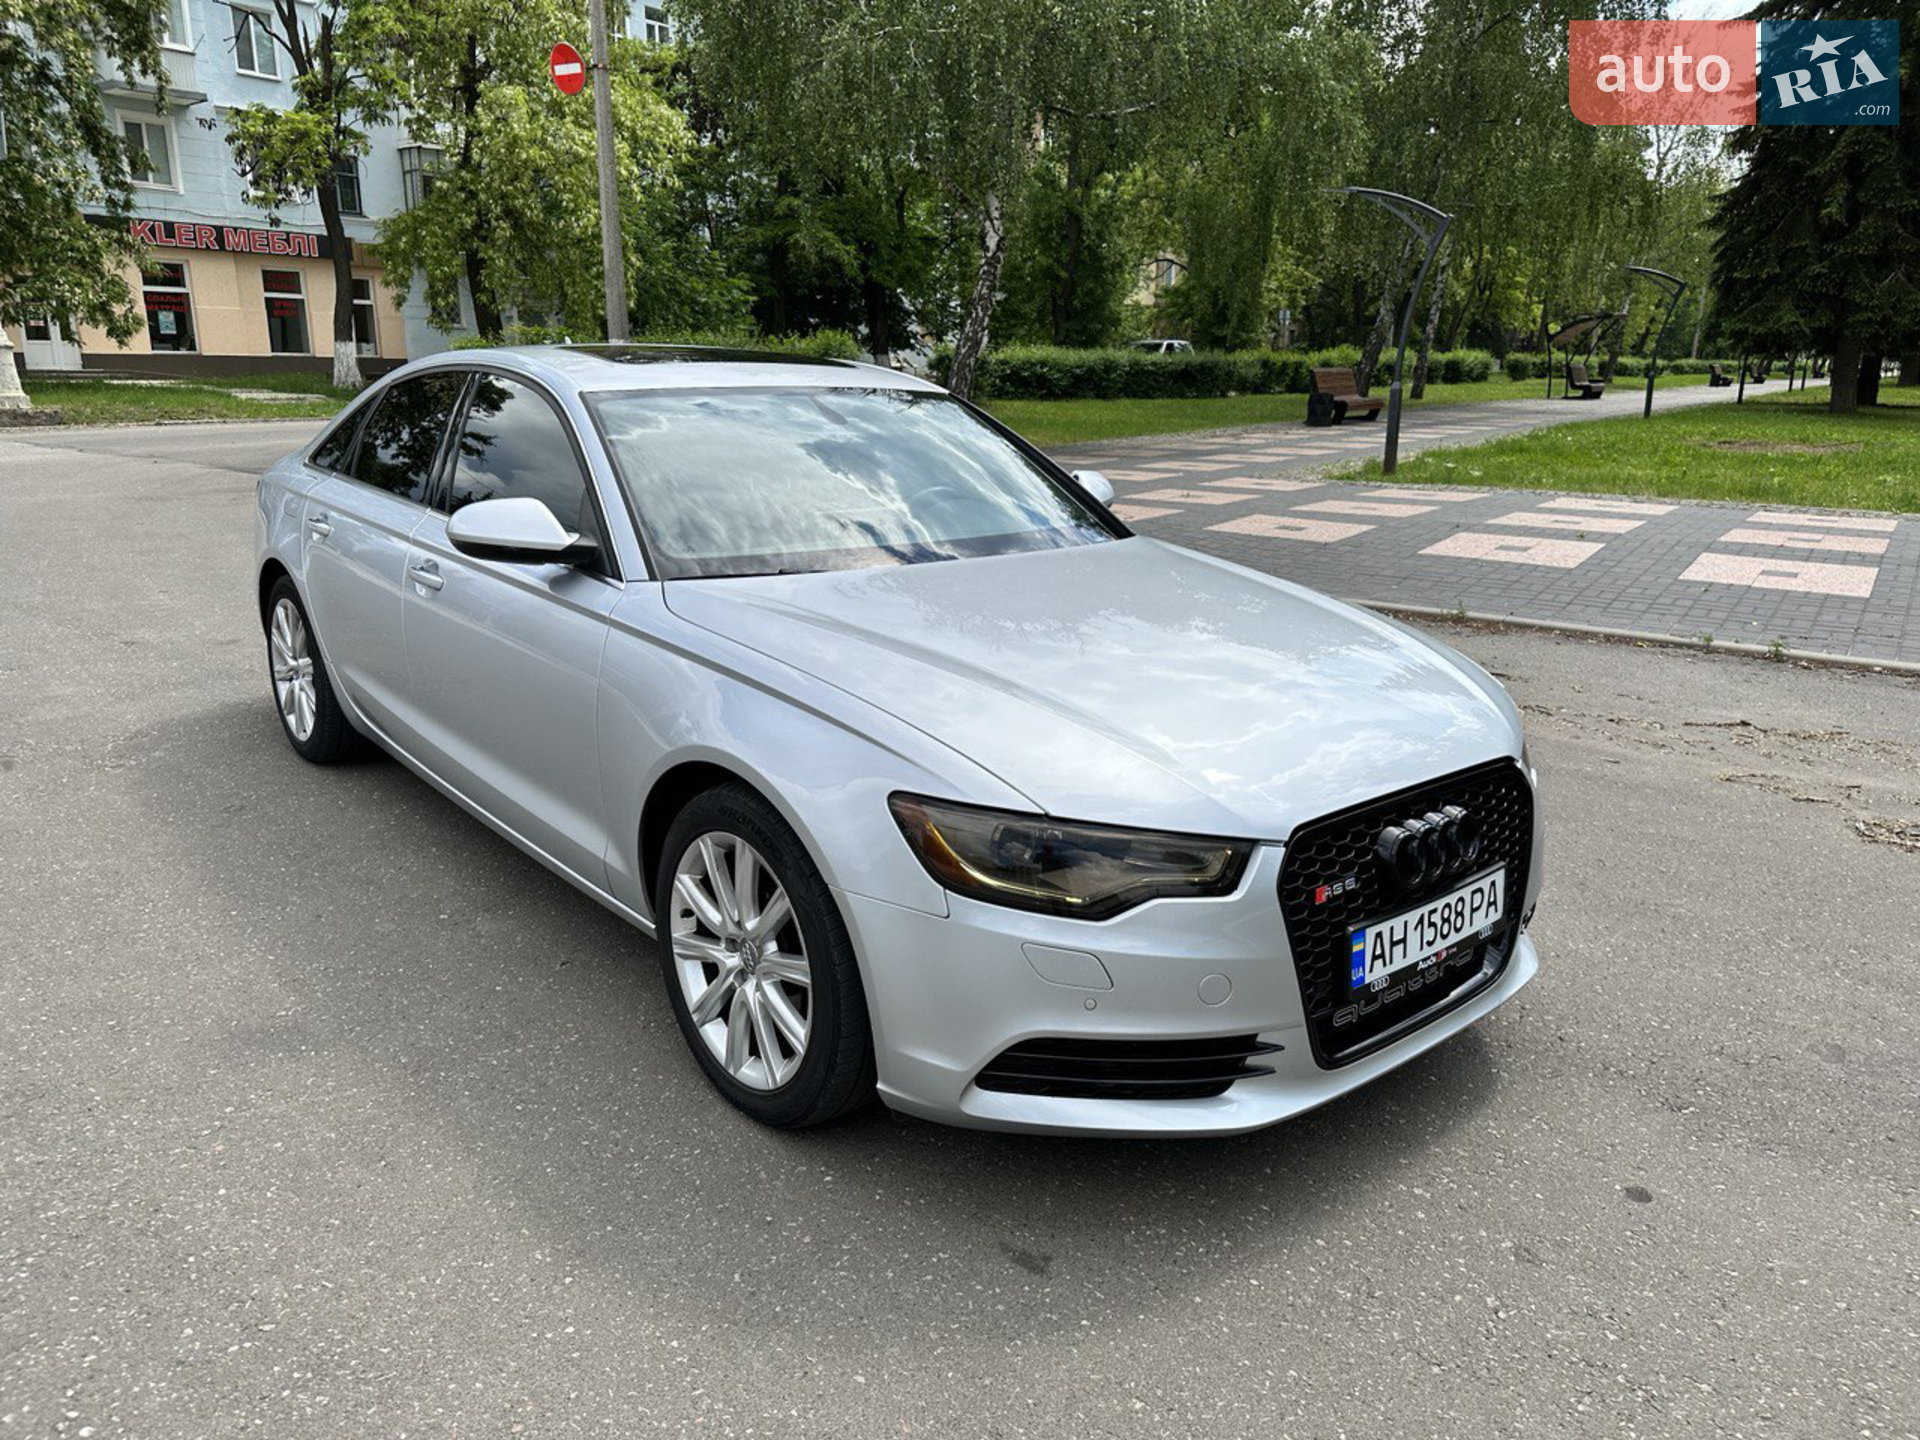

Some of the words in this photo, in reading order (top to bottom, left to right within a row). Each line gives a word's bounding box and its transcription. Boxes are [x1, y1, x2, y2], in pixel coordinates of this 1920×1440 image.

[130, 220, 219, 250] KLER
[223, 227, 319, 257] МЕБЛІ
[1369, 919, 1408, 973] AH
[1413, 896, 1465, 952] 1588
[1469, 880, 1499, 927] PA
[1352, 967, 1364, 981] UA
